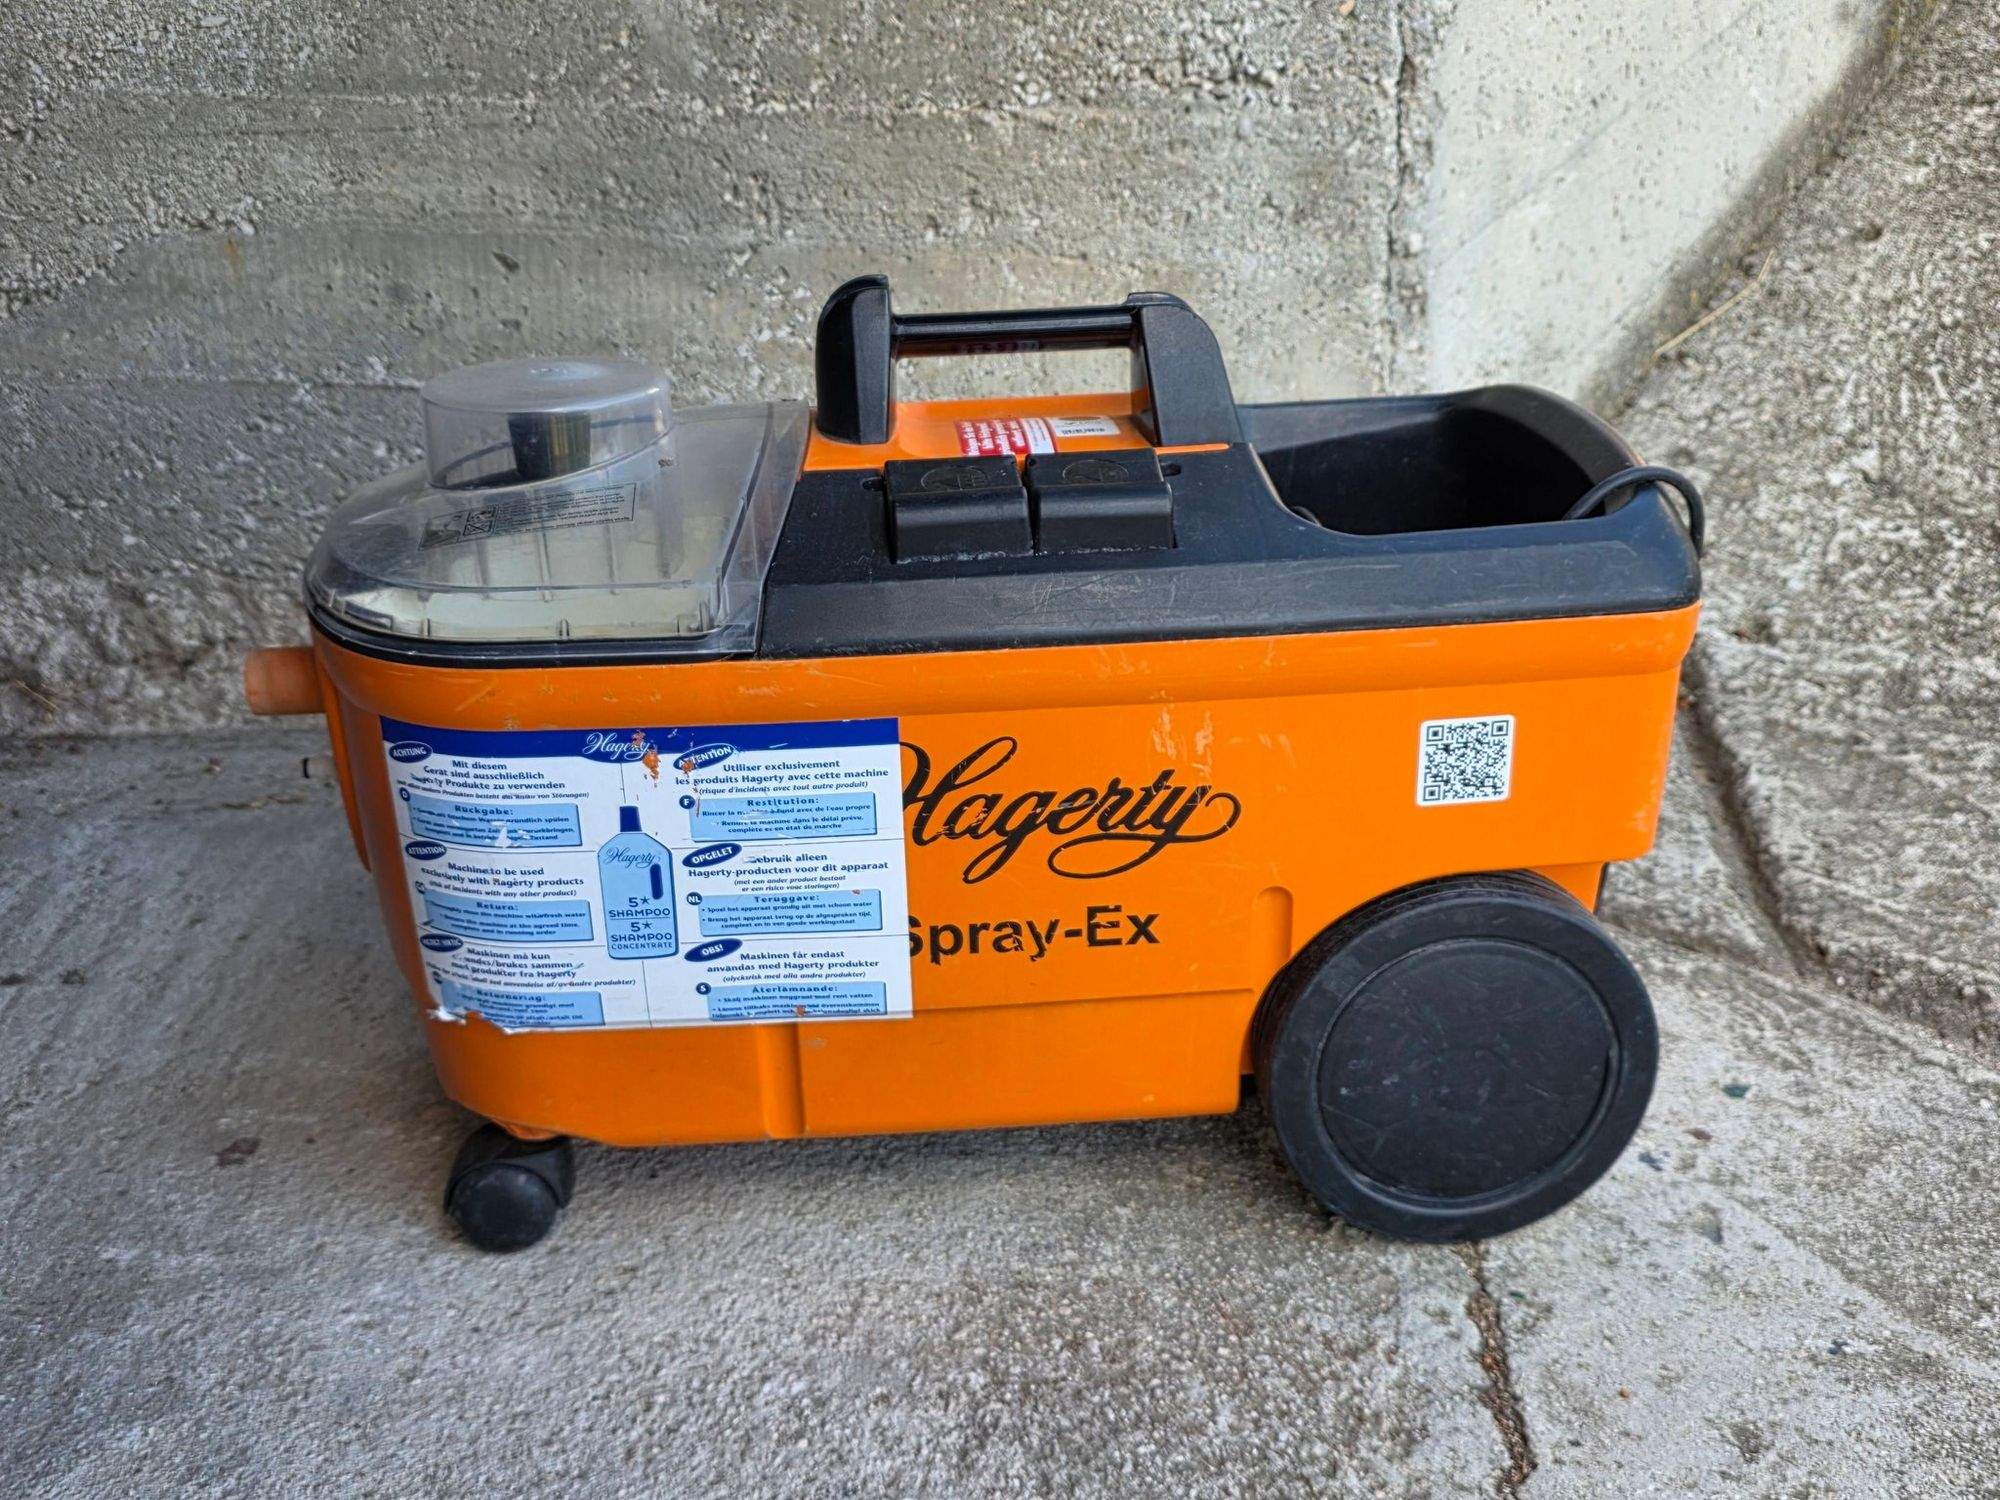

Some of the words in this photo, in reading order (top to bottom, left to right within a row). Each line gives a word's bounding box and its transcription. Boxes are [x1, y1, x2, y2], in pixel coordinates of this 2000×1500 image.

[582, 731, 652, 760] Hagerty
[392, 746, 427, 758] ACHTUNG
[452, 760, 469, 768] Mit
[472, 762, 507, 770] diesem
[722, 764, 762, 772] Utiliser
[765, 760, 840, 770] exclusivement
[451, 770, 470, 779] sind
[473, 772, 544, 780] ausschließlich
[675, 776, 690, 785] les
[694, 776, 739, 786] produits
[742, 774, 784, 784] Hagerty
[788, 773, 811, 781] avec
[814, 772, 841, 780] cette
[844, 768, 889, 778] machine
[446, 778, 490, 790] Produkte
[508, 782, 566, 790] verwenden
[699, 788, 726, 796] (risque
[773, 784, 791, 792] avec
[793, 782, 810, 790] tout
[812, 782, 834, 790] autre
[836, 781, 868, 791] produit)
[846, 804, 870, 812] propre
[901, 736, 1241, 884] Hagerty
[408, 846, 446, 856] ATTENTION
[692, 846, 734, 864] OPGELET
[602, 846, 656, 868] Hagerty
[796, 853, 828, 862] alleen
[448, 862, 488, 874] Machine
[520, 867, 545, 876] used
[688, 866, 792, 878] Hagerty-producten
[822, 864, 838, 872] dit
[840, 862, 889, 872] apparaat
[468, 876, 490, 885] with
[492, 878, 534, 888] Hagerty
[537, 878, 584, 888] products
[790, 876, 818, 884] product
[542, 890, 578, 898] product)
[608, 908, 670, 918] SHAMPOO
[611, 932, 672, 942] SHAMPOO
[908, 904, 1161, 965] Spray-Ex
[611, 942, 673, 950] CONCENTRATE
[702, 944, 724, 956] OBS!
[467, 947, 510, 958] Maskinen
[740, 952, 790, 960] Maskinen
[792, 950, 808, 958] får
[811, 950, 844, 958] endast
[758, 962, 780, 970] med
[784, 961, 824, 970] Hagerty
[828, 960, 880, 970] produkter
[537, 970, 576, 979] Hagerty
[825, 972, 866, 980] produkter)
